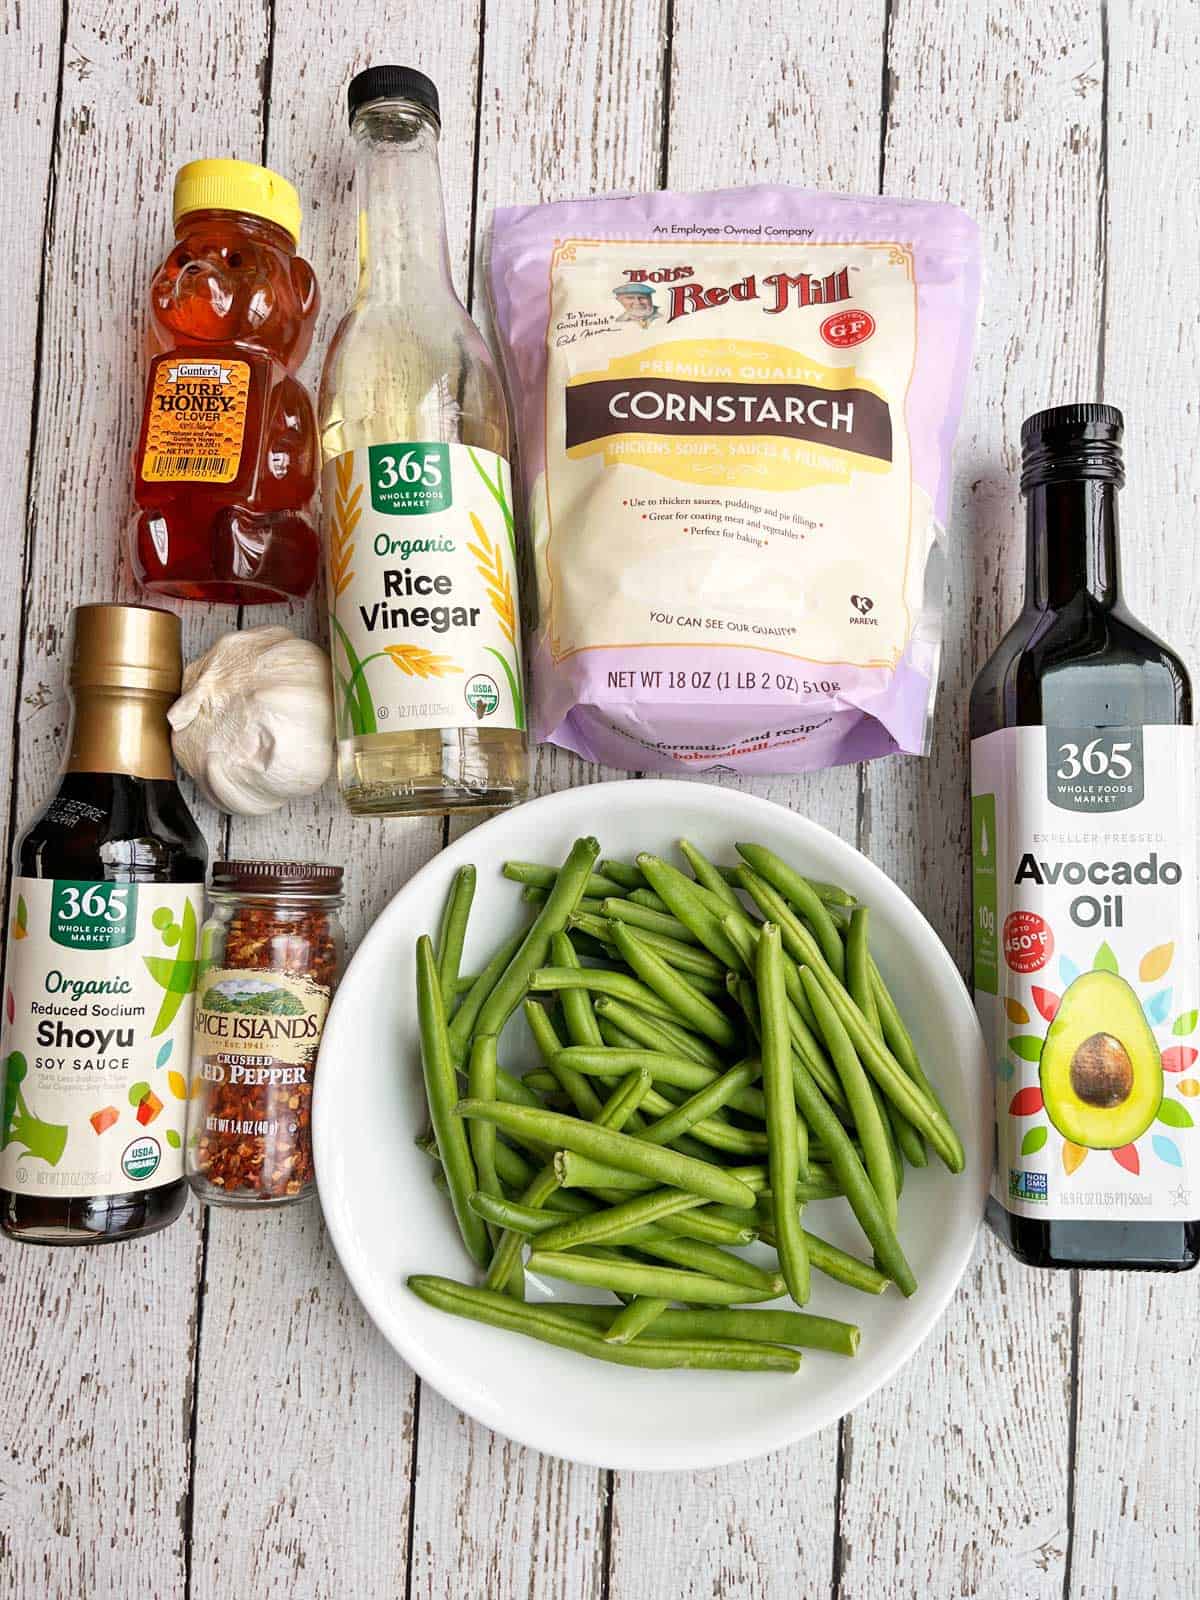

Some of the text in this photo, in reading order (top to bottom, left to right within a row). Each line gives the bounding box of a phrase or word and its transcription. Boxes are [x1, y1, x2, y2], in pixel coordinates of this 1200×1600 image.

[653, 225, 668, 233] An
[764, 226, 814, 238] Company
[622, 265, 853, 323] Bob's Red Mill
[567, 311, 596, 320] To Your
[557, 320, 578, 330] Good
[180, 366, 219, 377] Gunter's
[639, 360, 824, 382] PREMIUM QUALITY
[175, 383, 223, 396] PURE
[157, 395, 236, 412] HONEY
[175, 411, 220, 421] CLOVER
[608, 391, 854, 433] CORNSTARCH
[607, 442, 671, 456] THICKENS
[378, 451, 442, 489] 365
[379, 491, 443, 501] WHOLE FOODS
[393, 500, 430, 508] MARKET
[630, 496, 817, 528] Use to thicken sauces, puddings and pie fillings
[648, 511, 799, 540] Great for coating meat and vegetables
[691, 526, 763, 548] Perfect for baking
[374, 533, 456, 560] Organic
[383, 568, 452, 597] Rice
[359, 602, 480, 633] Vinegar
[649, 611, 674, 625] YOU
[676, 615, 702, 628] CAN
[705, 618, 723, 630] SEE
[726, 621, 750, 633] OUR
[849, 617, 879, 626] PAREVE
[473, 684, 493, 694] USDA
[608, 671, 841, 694] NET WT 18 OZ (1 LB 2 OZ) 510g
[1057, 738, 1133, 780] 365
[1057, 785, 1133, 793] WHOLE FOODS
[1074, 795, 1117, 803] MARKET
[1033, 833, 1098, 843] EXPELLER
[1014, 852, 1183, 886] Avocado
[58, 884, 128, 921] 365
[1069, 894, 1124, 928] Oil
[979, 906, 994, 936] 10g
[58, 925, 126, 934] WHOLE FOODS
[72, 934, 111, 942] MARKET
[45, 970, 133, 1001] Organic
[31, 1002, 145, 1017] Reduced Sodium
[37, 1020, 135, 1054] Shoyu
[35, 1057, 129, 1070] SOY SAUCE
[217, 1053, 273, 1066] CRUSHED
[229, 1065, 307, 1085] PEPPER
[219, 1118, 229, 1132] WT
[231, 1120, 242, 1134] 1.4
[243, 1120, 254, 1134] OZ
[132, 1146, 154, 1158] USDA
[128, 1158, 156, 1170] ORGANIC
[1027, 1173, 1046, 1181] NON
[1027, 1180, 1046, 1188] GMO
